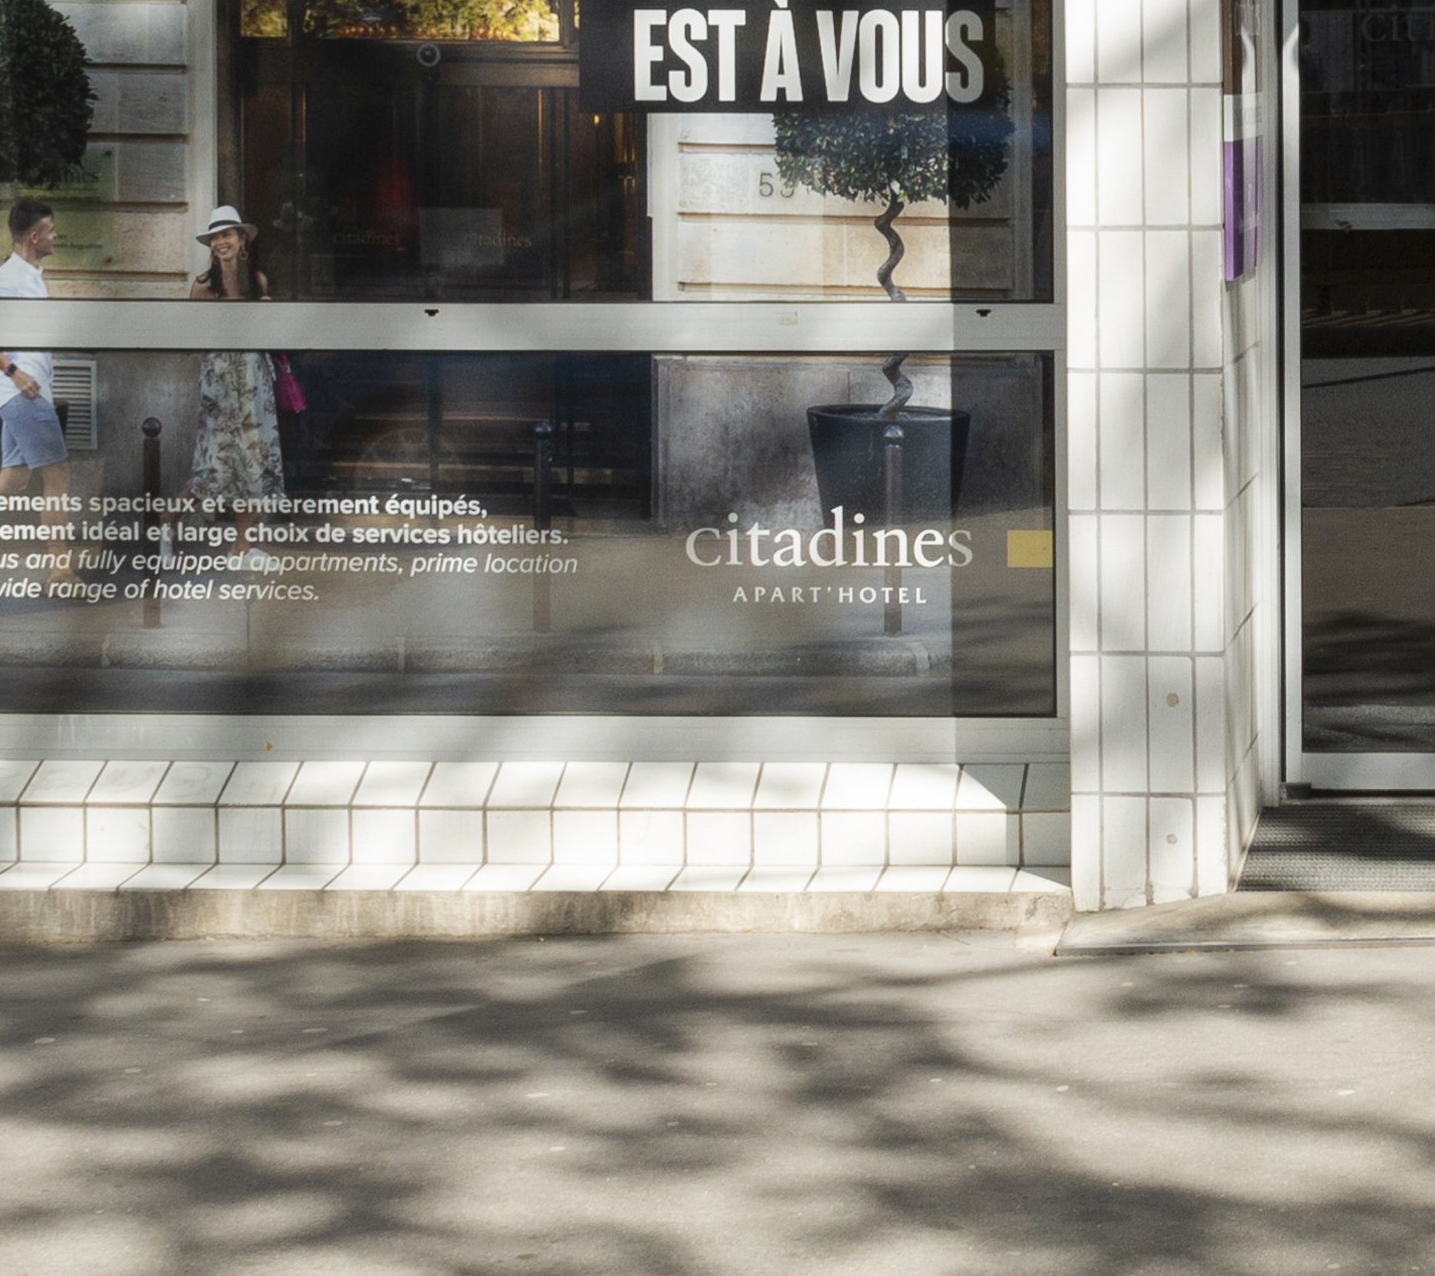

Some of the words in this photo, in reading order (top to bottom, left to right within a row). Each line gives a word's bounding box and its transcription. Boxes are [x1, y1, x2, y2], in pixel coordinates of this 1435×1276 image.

[633, 8, 746, 103] EST
[816, 8, 984, 103] VOUS
[89, 493, 195, 517] spacieux
[201, 495, 226, 513] et
[232, 493, 379, 515] entièrement
[385, 493, 487, 519] équipés,
[82, 520, 139, 541] idéal
[146, 523, 171, 542] et
[177, 522, 238, 547] large
[245, 522, 309, 544] choix
[315, 522, 346, 544] de
[352, 522, 450, 544] services
[457, 523, 569, 545] hôteliers.
[685, 505, 974, 568] citadines
[25, 549, 72, 570] and
[77, 549, 126, 574] fully
[132, 551, 244, 576] equipped
[250, 553, 404, 577] appartments,
[410, 553, 478, 578] prime
[485, 553, 579, 574] location
[48, 582, 117, 604] range
[124, 578, 147, 599] of
[153, 579, 213, 599] hotel
[218, 580, 319, 600] services.
[732, 585, 927, 604] APART'HOTEL
